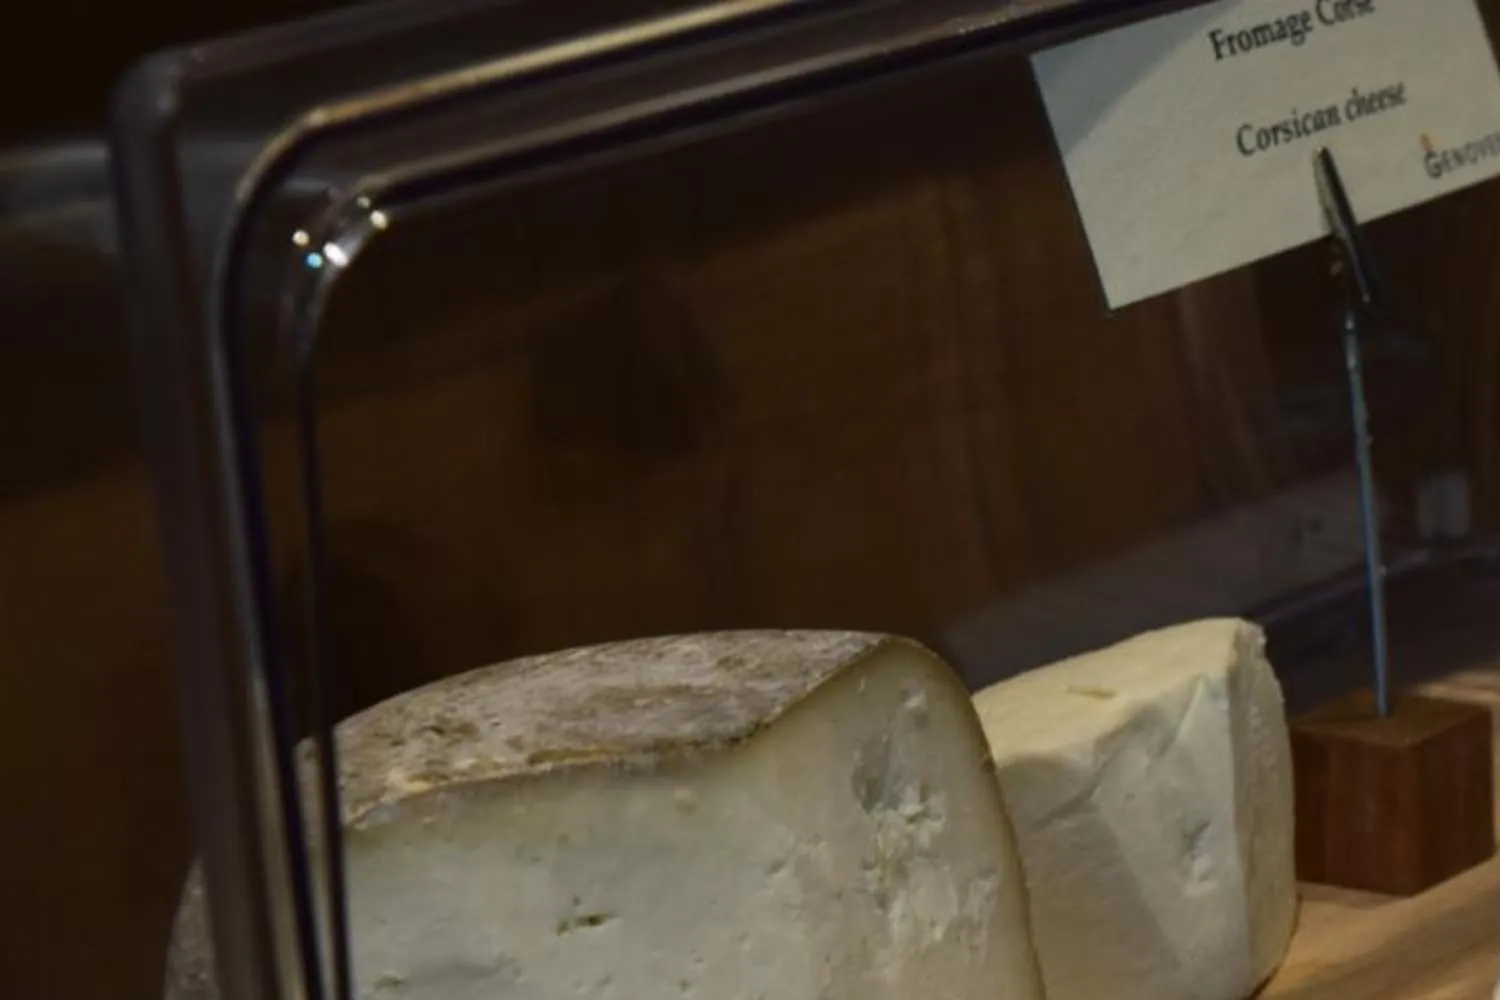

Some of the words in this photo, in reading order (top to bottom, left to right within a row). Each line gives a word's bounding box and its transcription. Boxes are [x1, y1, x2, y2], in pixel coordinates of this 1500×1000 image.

[1208, 9, 1314, 61] Fromage
[1235, 106, 1342, 157] Corsican
[1344, 81, 1407, 122] cheese
